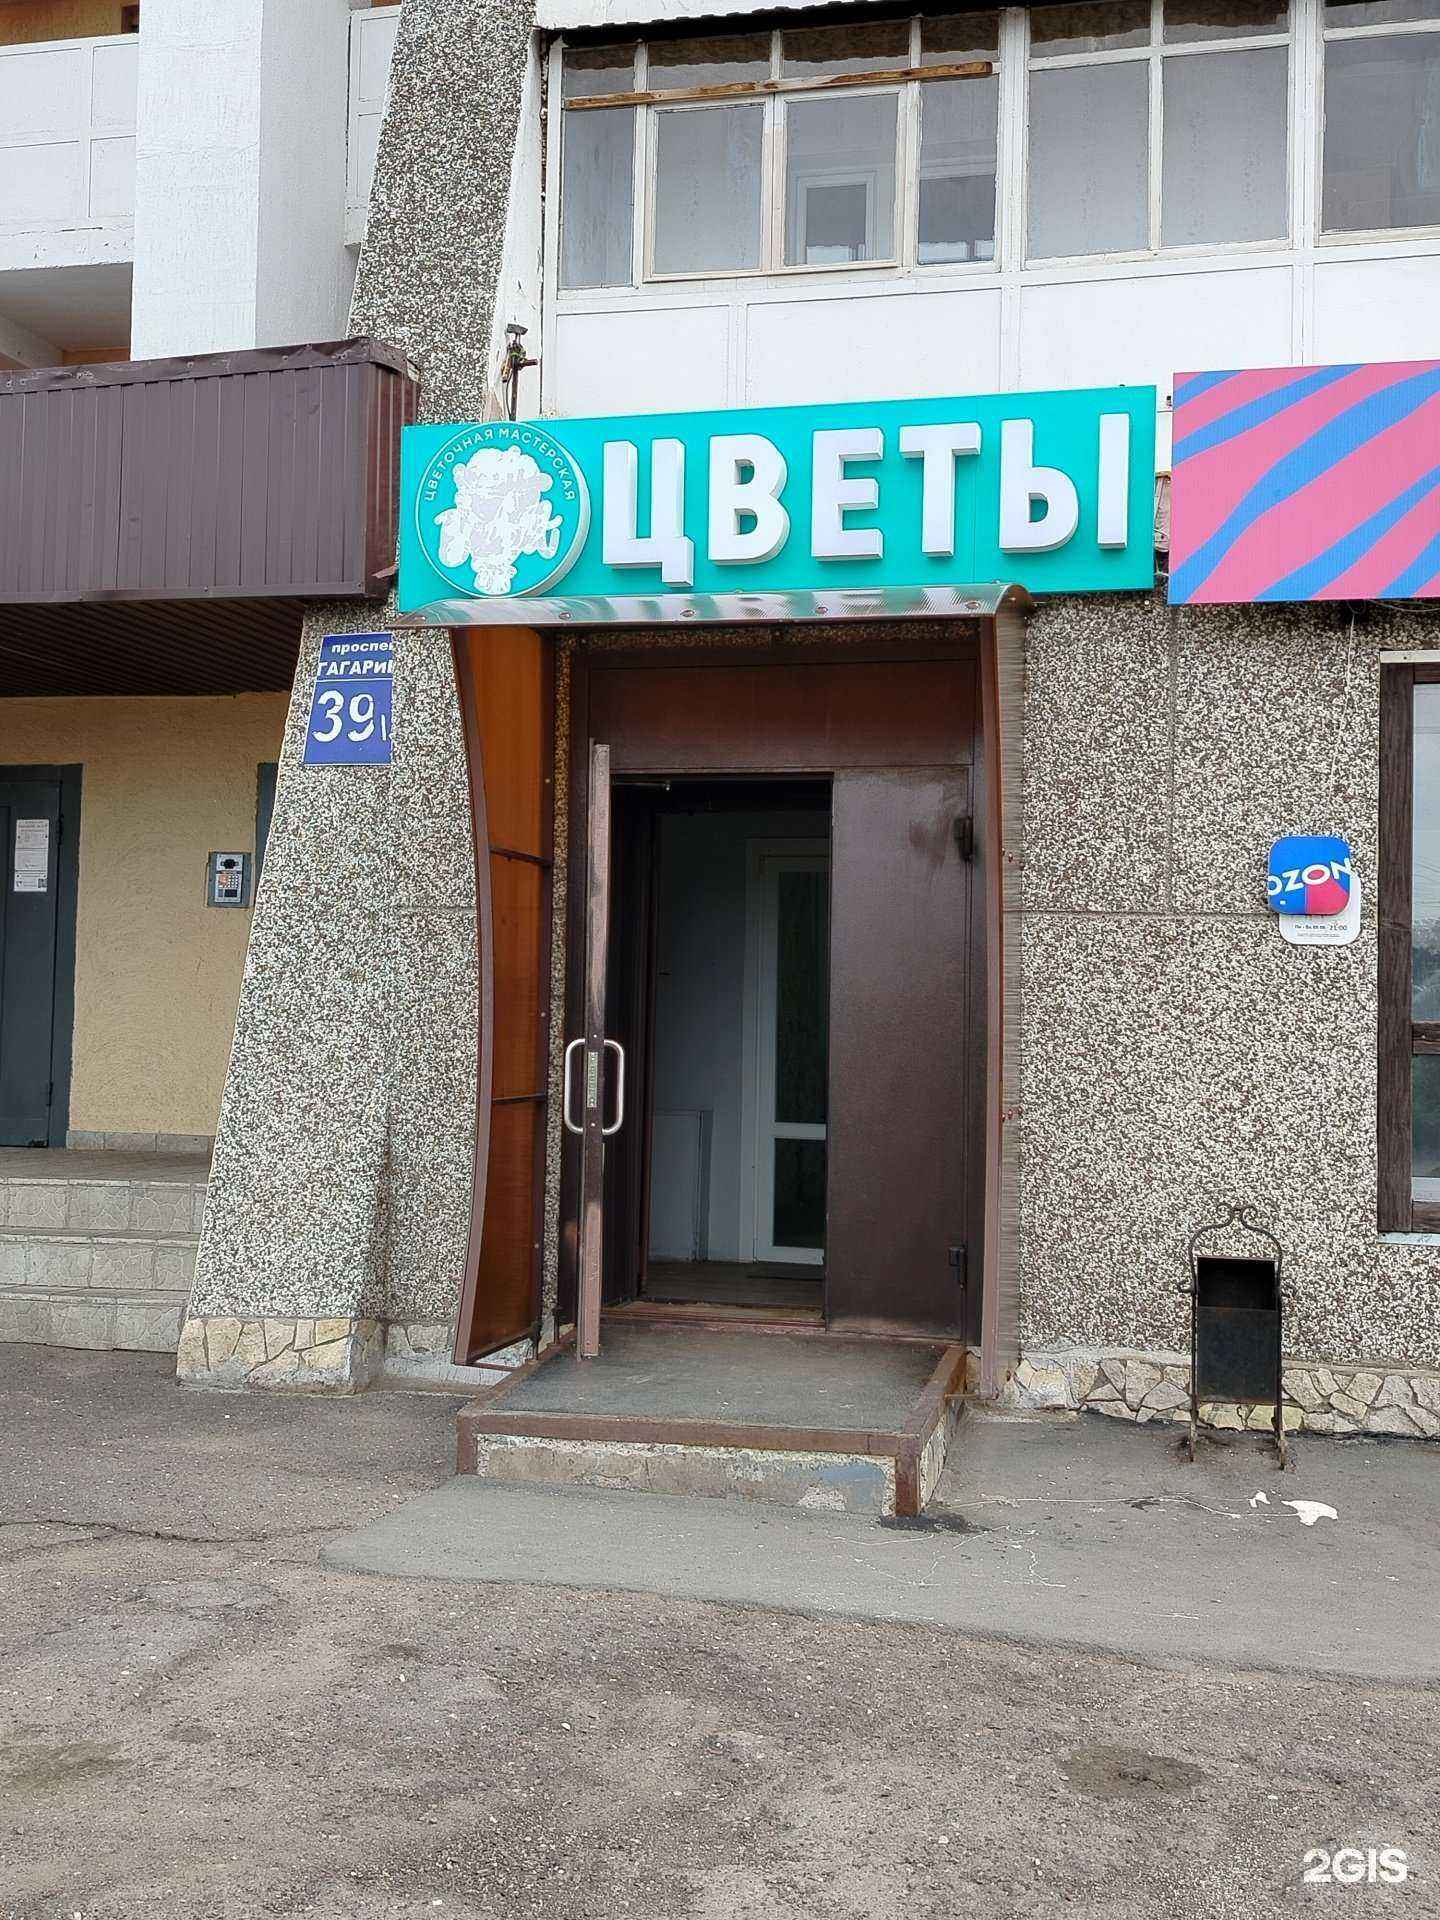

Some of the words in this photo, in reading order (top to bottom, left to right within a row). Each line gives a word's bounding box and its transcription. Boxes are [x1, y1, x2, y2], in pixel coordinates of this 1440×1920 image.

[424, 428, 494, 501] ЦВЕТОЧНАЯ
[498, 428, 576, 501] МАСТЕРСКАЯ
[602, 412, 1131, 588] ЦВЕТЫ
[1267, 857, 1357, 896] OZON
